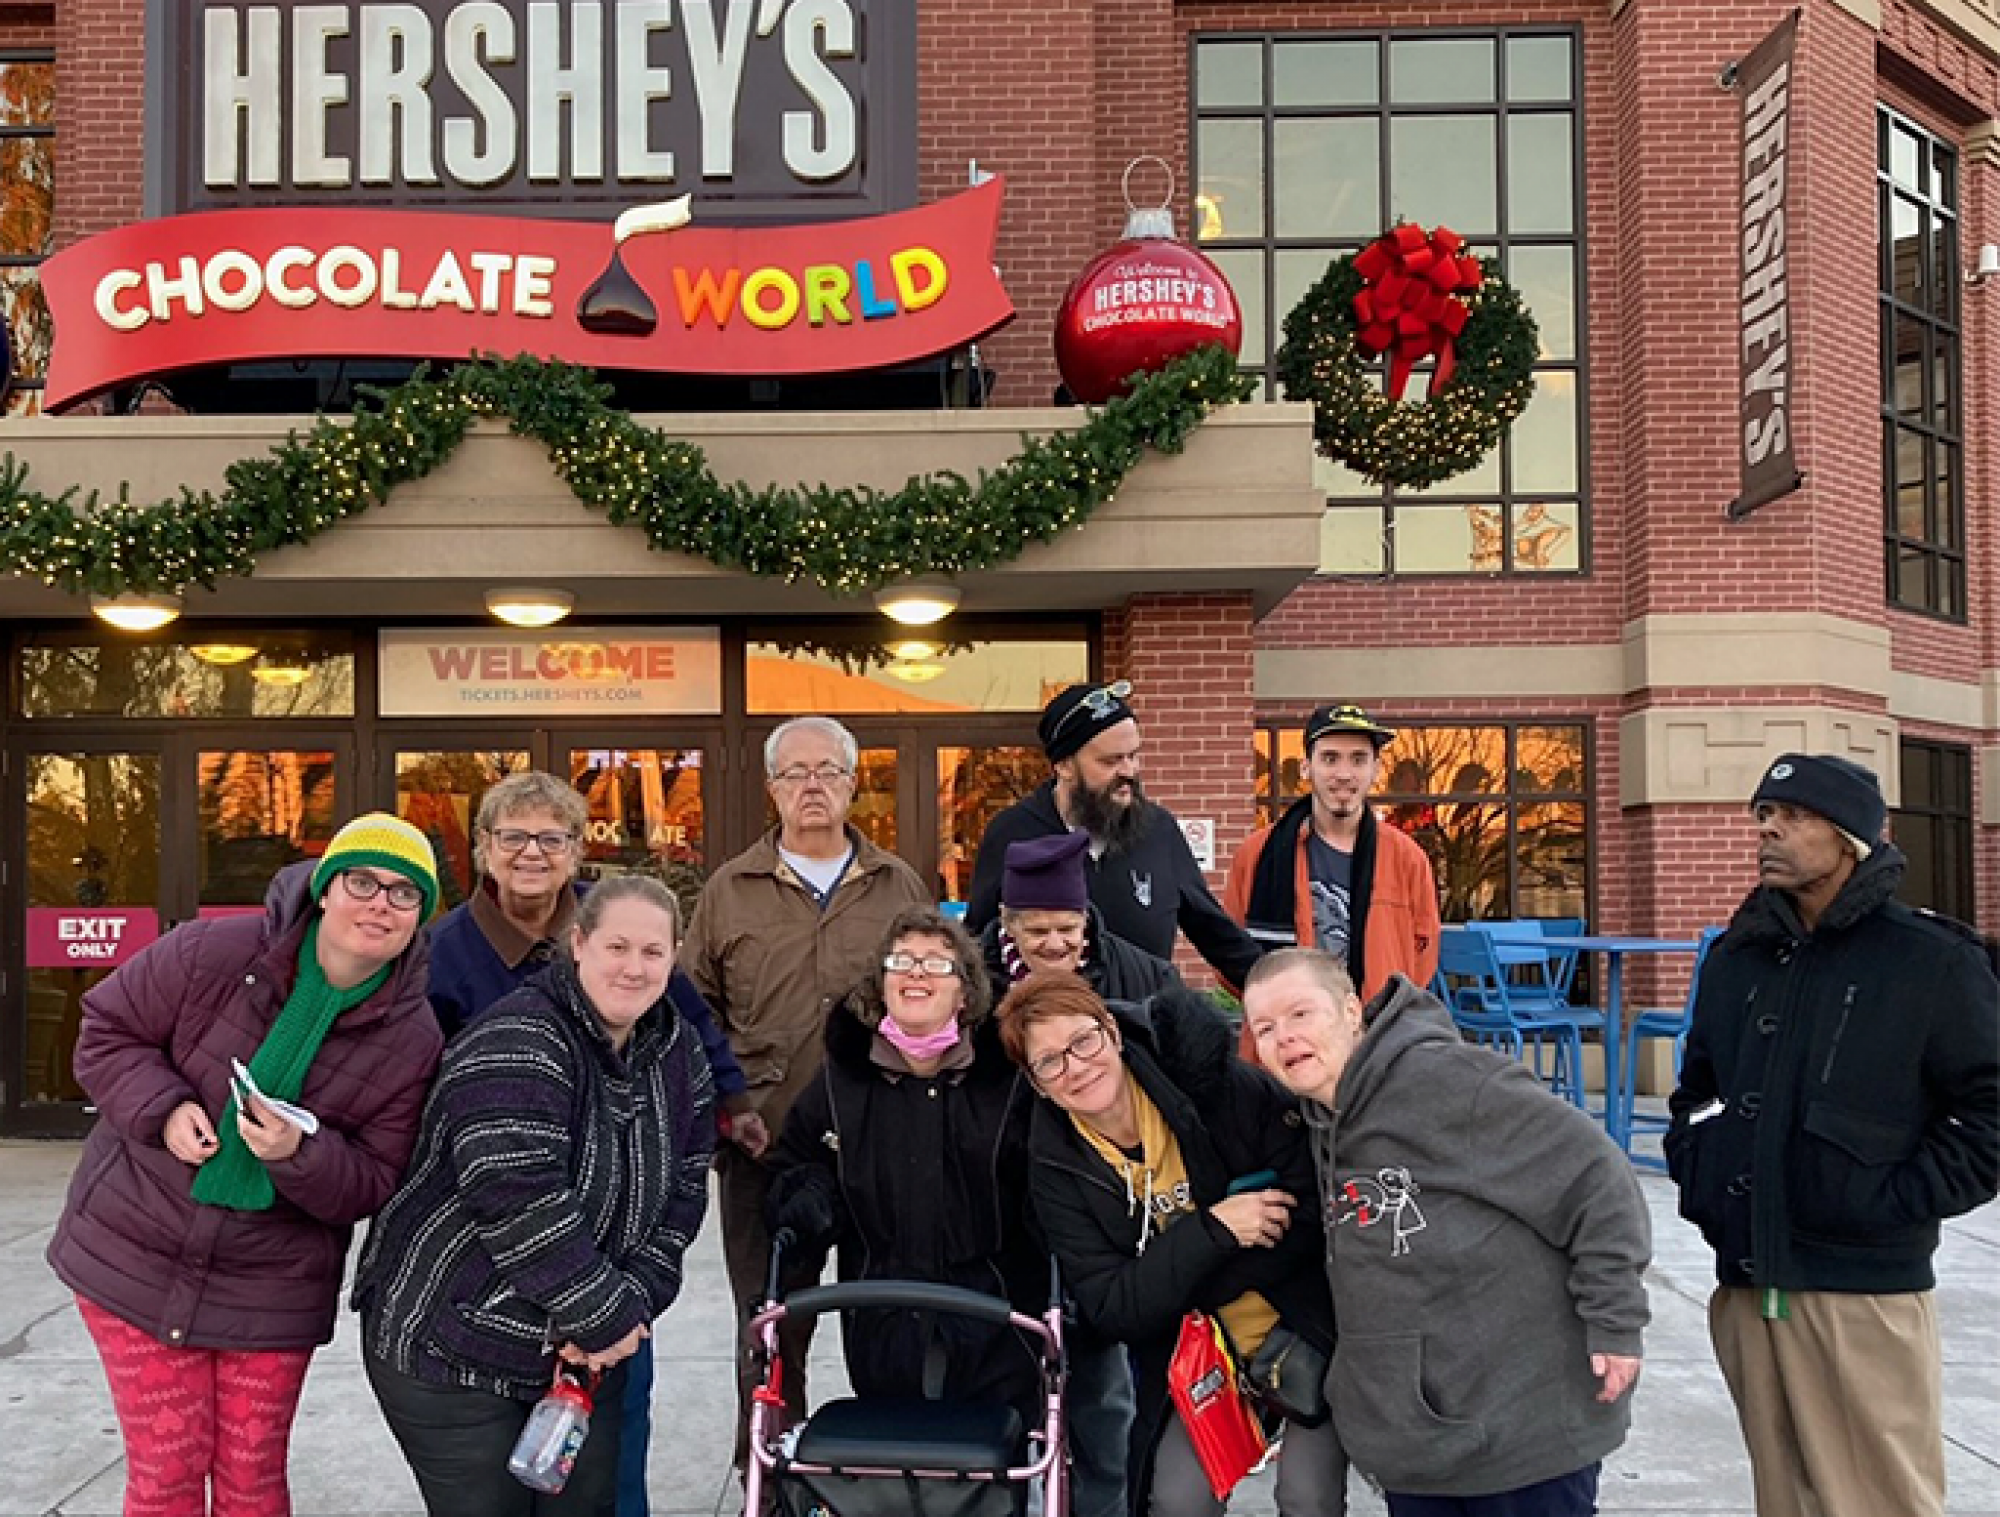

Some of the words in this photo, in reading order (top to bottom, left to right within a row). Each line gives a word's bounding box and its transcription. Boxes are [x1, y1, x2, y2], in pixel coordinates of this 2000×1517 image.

[203, 0, 857, 187] HERSHEY'S
[1742, 62, 1788, 467] HERSHEY'S
[93, 245, 557, 332] CHOCOLATE
[671, 245, 949, 331] WORLD
[1094, 278, 1216, 311] HERSHEY'S
[1084, 307, 1176, 332] CHOCOLATE
[427, 646, 675, 680] WELCOME
[460, 687, 643, 702] TICKETS.HERSHEYS.COM
[58, 917, 127, 940] EXIT
[66, 942, 118, 959] ONLY
